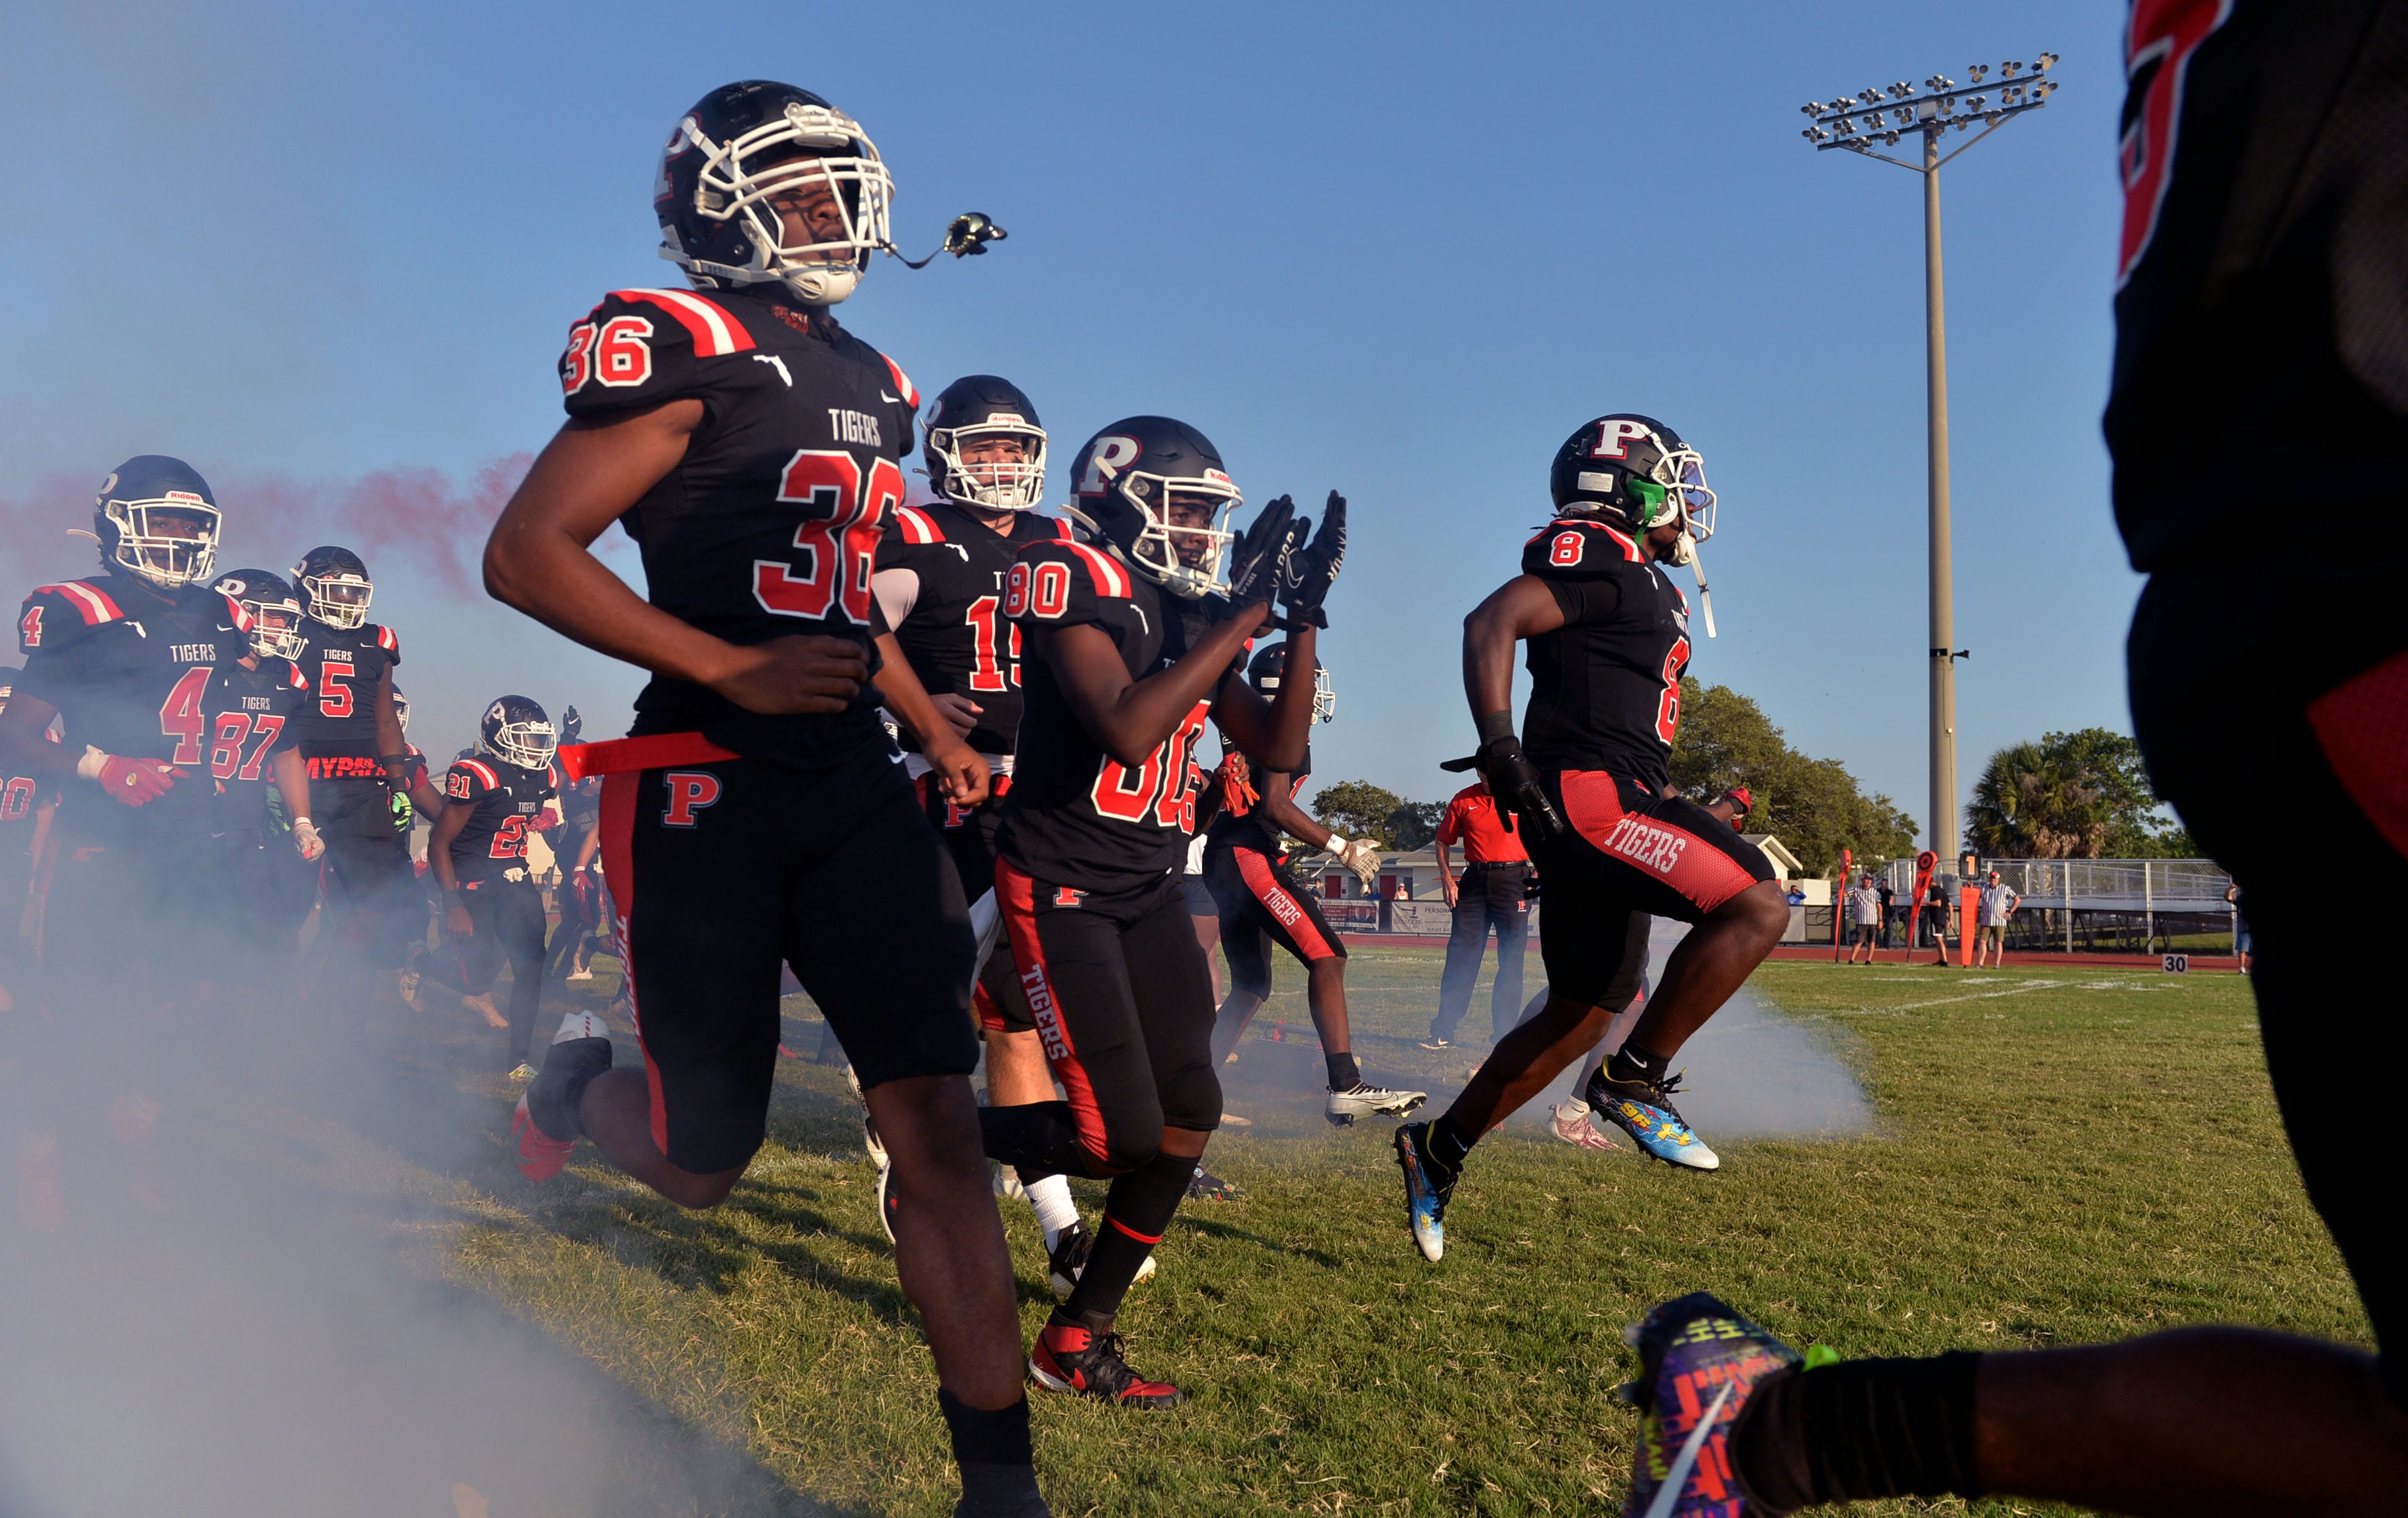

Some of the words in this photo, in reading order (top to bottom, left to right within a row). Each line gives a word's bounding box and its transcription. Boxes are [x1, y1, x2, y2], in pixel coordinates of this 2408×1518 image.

[558, 316, 654, 398] 36
[828, 408, 881, 447] TIGERS
[1590, 418, 1650, 460] P
[1078, 433, 1143, 498] P
[752, 449, 905, 626] 36
[1549, 530, 1585, 566] 8
[1003, 561, 1071, 618] 80
[22, 606, 45, 647] 4
[170, 644, 217, 663] TIGERS
[323, 648, 352, 662] TIGERS
[241, 696, 271, 711] TIGERS
[319, 661, 355, 718] 5
[159, 666, 214, 765] 4
[210, 711, 286, 781] 87
[447, 773, 471, 800] 21
[661, 770, 723, 829] P
[518, 802, 536, 813] TIGERS
[1604, 818, 1687, 874] TIGERS
[1966, 856, 1976, 876] 1
[1262, 887, 1302, 927] TIGERS
[2165, 955, 2187, 972] 30
[1021, 963, 1069, 1061] TIGERS
